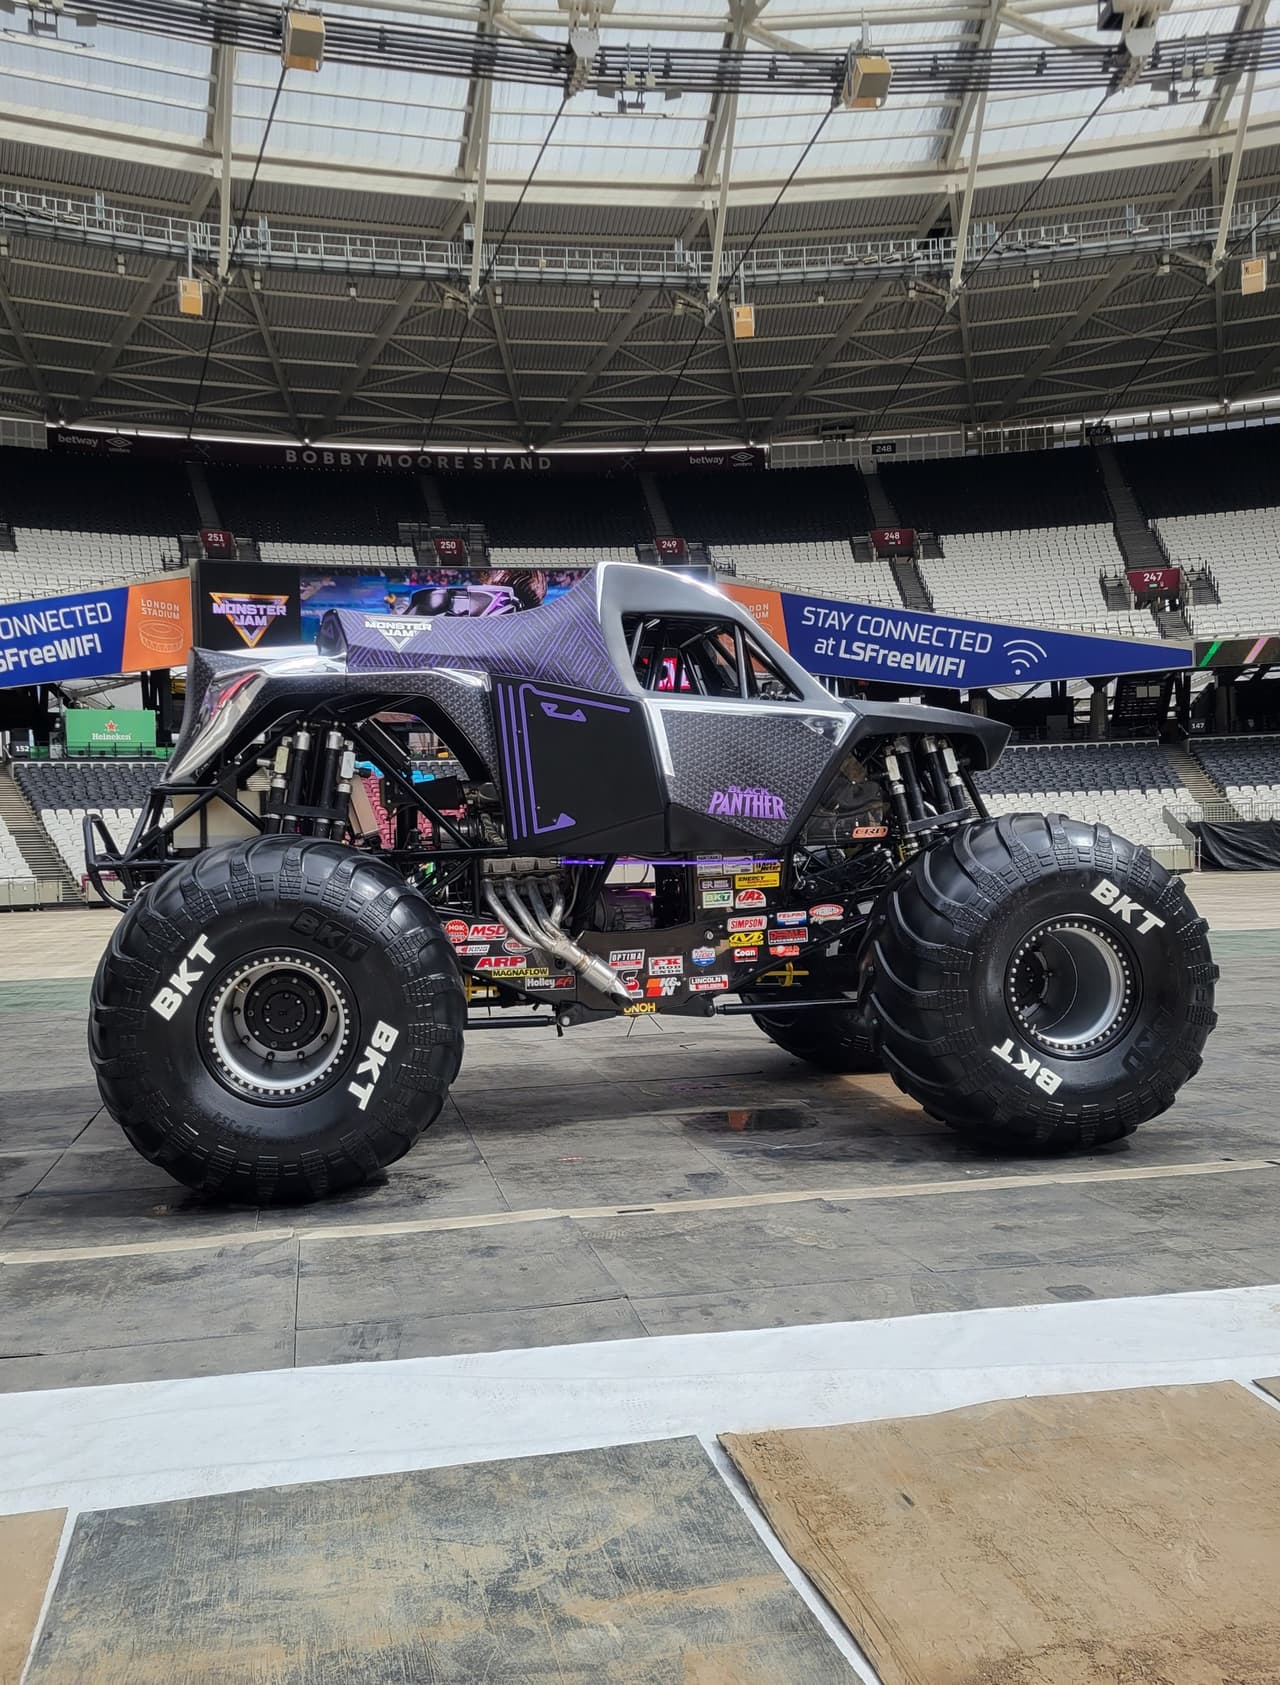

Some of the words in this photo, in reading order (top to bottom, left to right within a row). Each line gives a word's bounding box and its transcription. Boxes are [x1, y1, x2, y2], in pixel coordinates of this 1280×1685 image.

[57, 433, 98, 448] betway
[875, 445, 892, 453] 248
[285, 449, 369, 467] BOBBY
[376, 453, 465, 470] MOORE
[473, 456, 552, 470] STAND
[689, 455, 725, 466] betway
[207, 533, 225, 543] 251
[883, 531, 901, 541] 248
[440, 541, 456, 549] 250
[661, 540, 677, 549] 249
[1143, 572, 1163, 582] 247
[140, 599, 181, 612] LONDON
[212, 602, 287, 617] MONSTER
[140, 607, 181, 620] STADIUM
[234, 614, 268, 627] JAM
[364, 620, 432, 632] MONSTER
[382, 629, 415, 638] JAM
[801, 606, 854, 632] STAY
[856, 615, 993, 654] CONNECTED
[814, 637, 835, 656] at
[839, 639, 966, 680] LSFreeWIFI
[91, 732, 132, 741] Heineken
[15, 745, 30, 753] 152
[728, 785, 770, 795] BLACK
[707, 791, 789, 821] PANTHER
[737, 890, 764, 903] JAZ
[1089, 878, 1166, 936] BKT
[730, 918, 764, 930] SIMPSON
[289, 907, 375, 963] BKT
[470, 925, 507, 936] MSD
[611, 952, 641, 962] OPTIMA
[734, 948, 756, 958] Coan
[476, 956, 525, 969] ARP
[150, 933, 216, 1022] BKT
[493, 967, 548, 977] MAGNAFLOW
[526, 978, 555, 989] Holley
[691, 975, 721, 985] LINCOLN
[347, 1019, 400, 1112] BKT
[990, 1037, 1064, 1096] BKT
